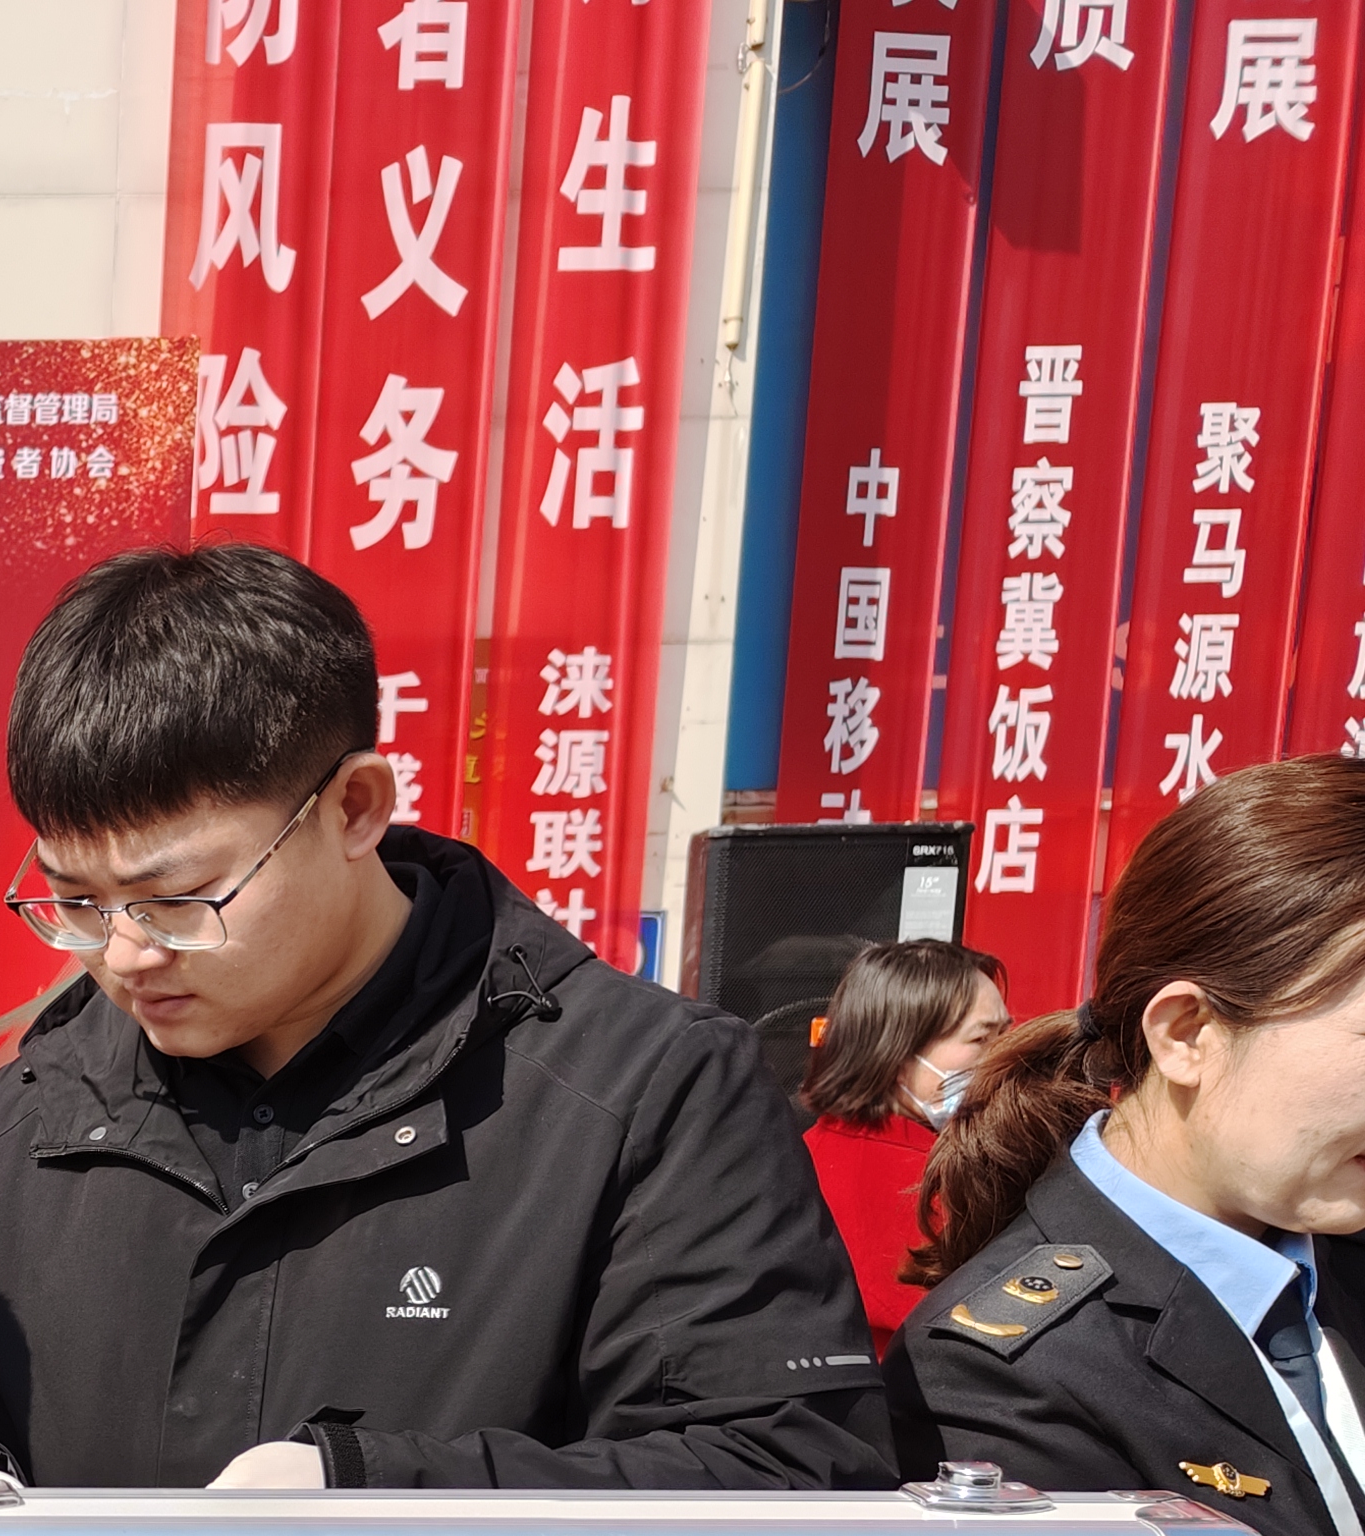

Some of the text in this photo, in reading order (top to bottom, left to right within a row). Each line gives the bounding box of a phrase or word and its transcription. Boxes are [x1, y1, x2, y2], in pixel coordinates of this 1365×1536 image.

[1211, 18, 1318, 143] 展
[975, 345, 1083, 893] 晋察冀饭店
[385, 1306, 451, 1319] RADIANT
